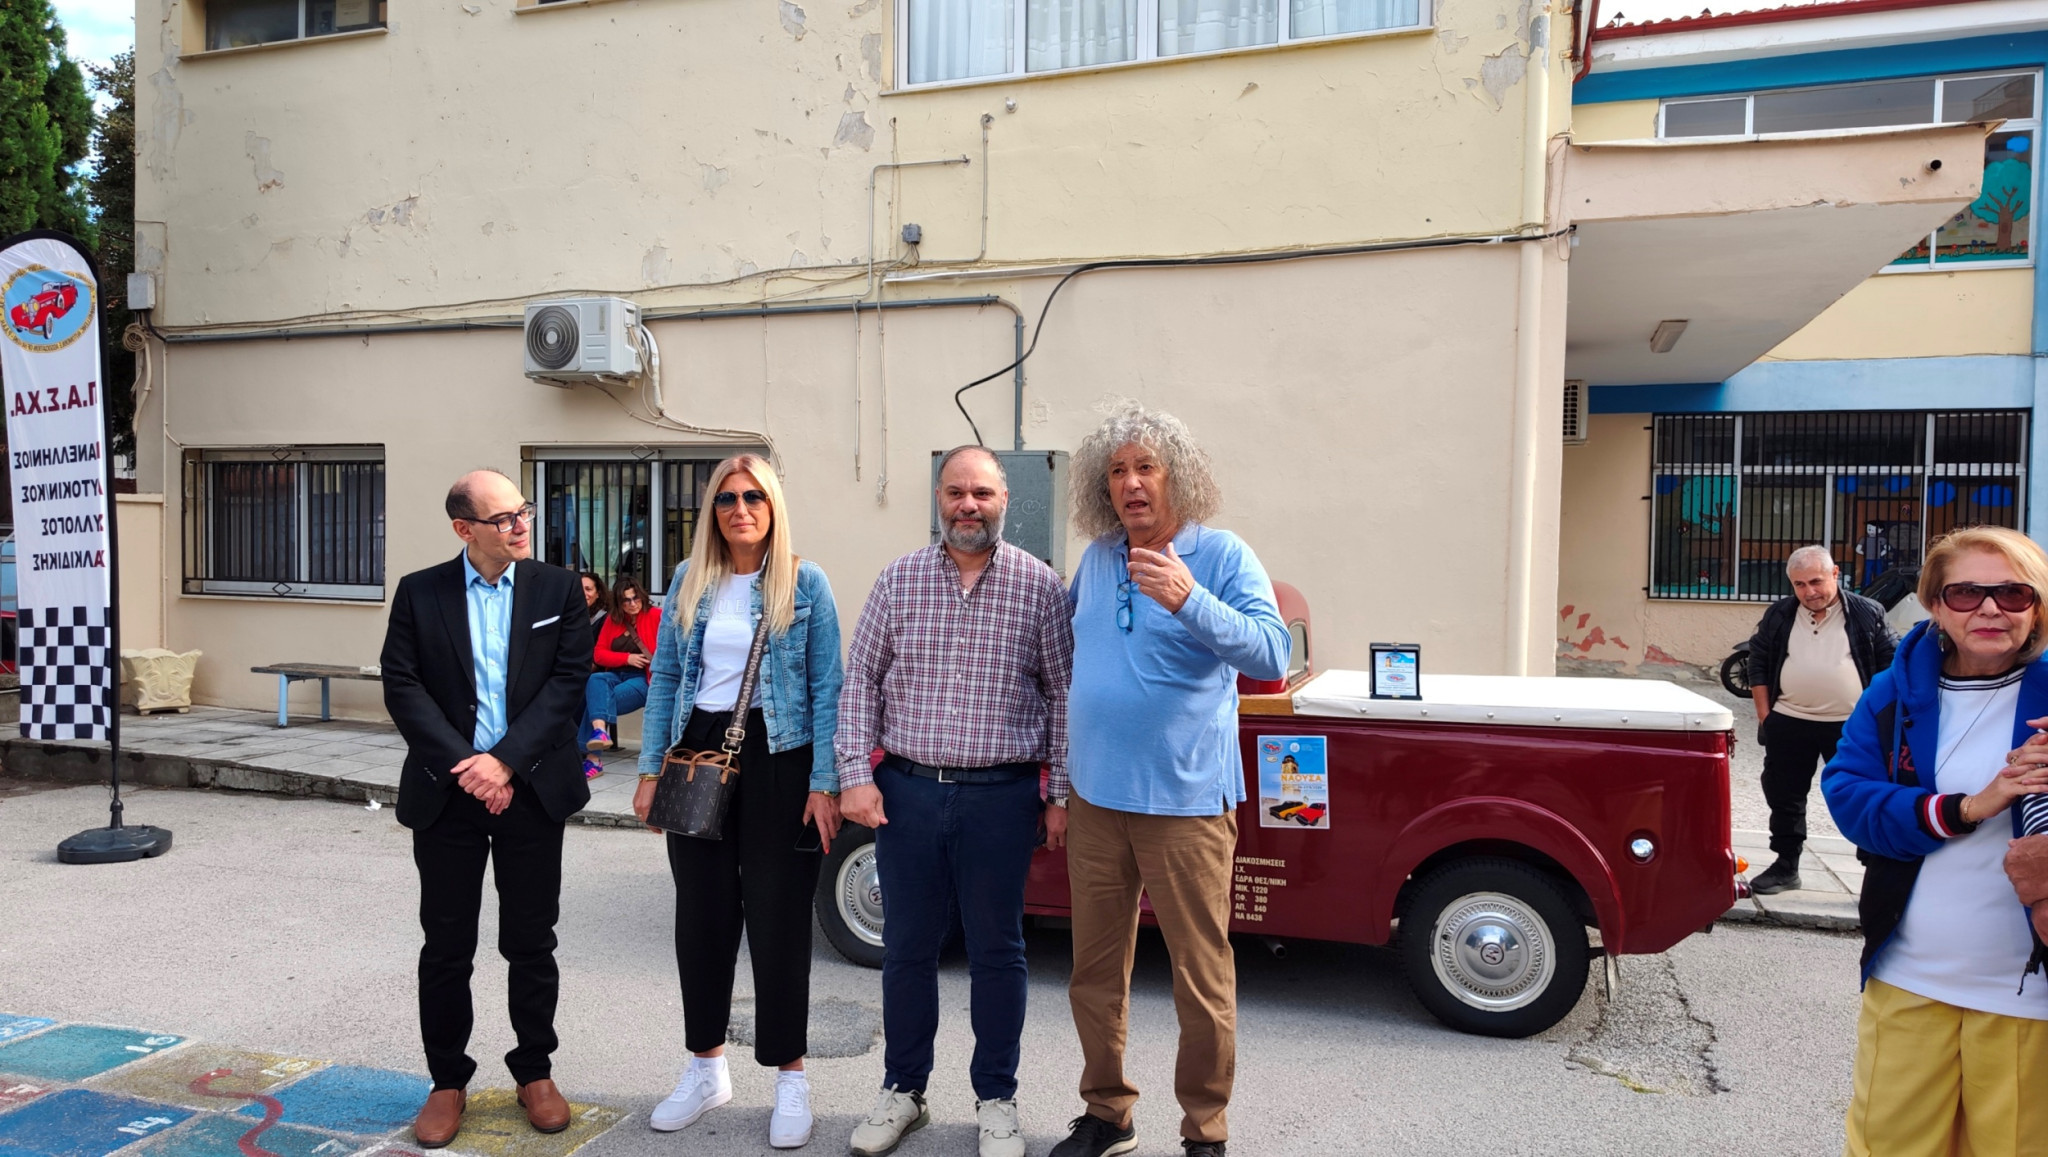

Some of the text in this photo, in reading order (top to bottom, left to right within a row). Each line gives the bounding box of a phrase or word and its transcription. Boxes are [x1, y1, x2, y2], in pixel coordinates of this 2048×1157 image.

[1281, 774, 1322, 782] ΝΑΟΥΣΑ
[1235, 856, 1286, 867] ΔΙΑΚΟΣΜΗΣΕΙΣ
[1235, 875, 1287, 887] ΕΔΡΑ ΘΕΣ/ΝΙΚΗ
[1235, 884, 1269, 894] ΜΙΚ. 1220
[1255, 895, 1268, 904] 380
[124, 1036, 177, 1053] 16
[116, 1116, 173, 1136] 14
